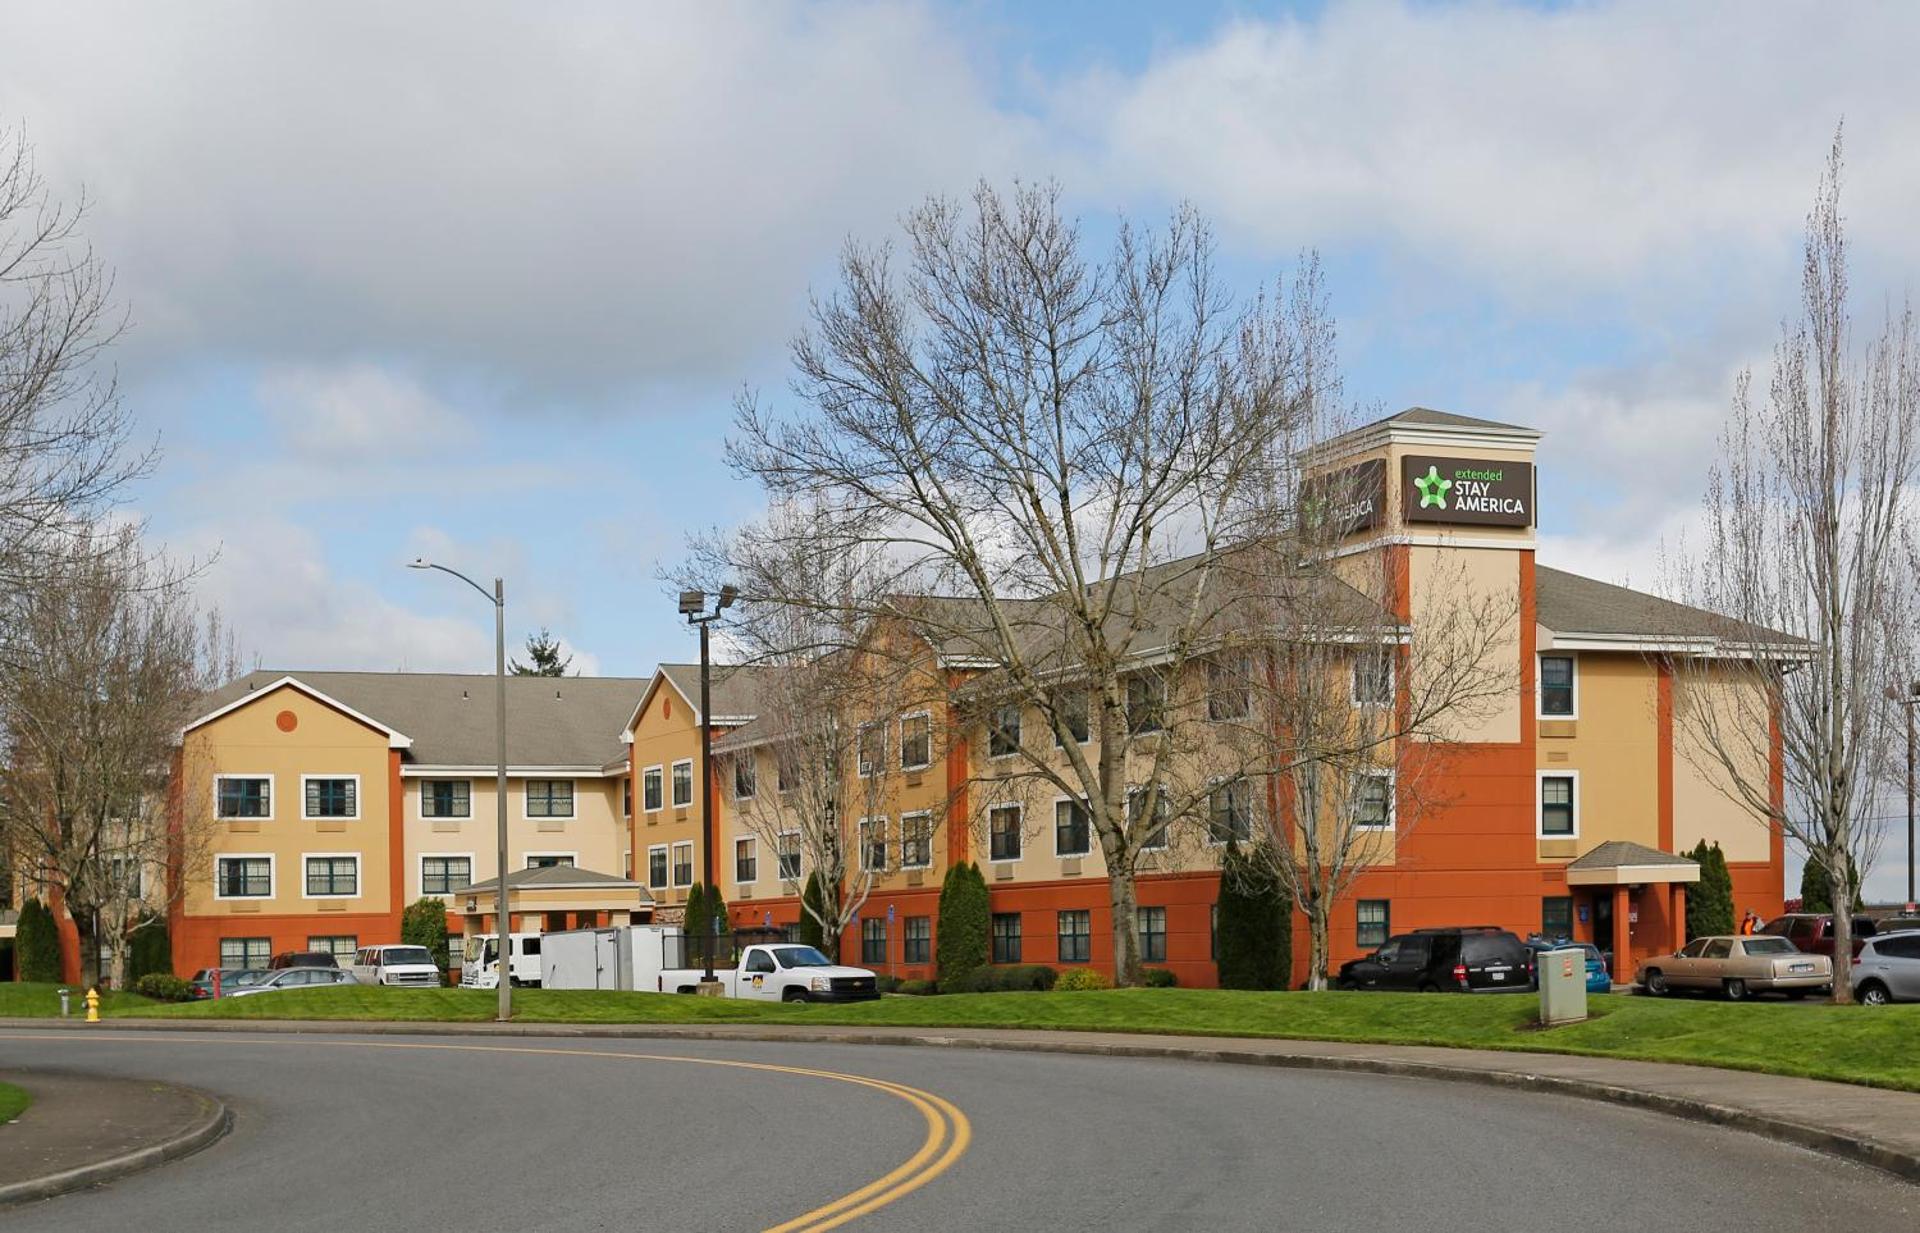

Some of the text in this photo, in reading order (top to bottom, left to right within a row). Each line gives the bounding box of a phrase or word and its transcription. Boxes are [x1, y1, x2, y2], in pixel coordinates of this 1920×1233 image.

[1455, 469, 1503, 480] extended
[1455, 480, 1490, 496] STAY
[1455, 496, 1524, 514] AMERICA
